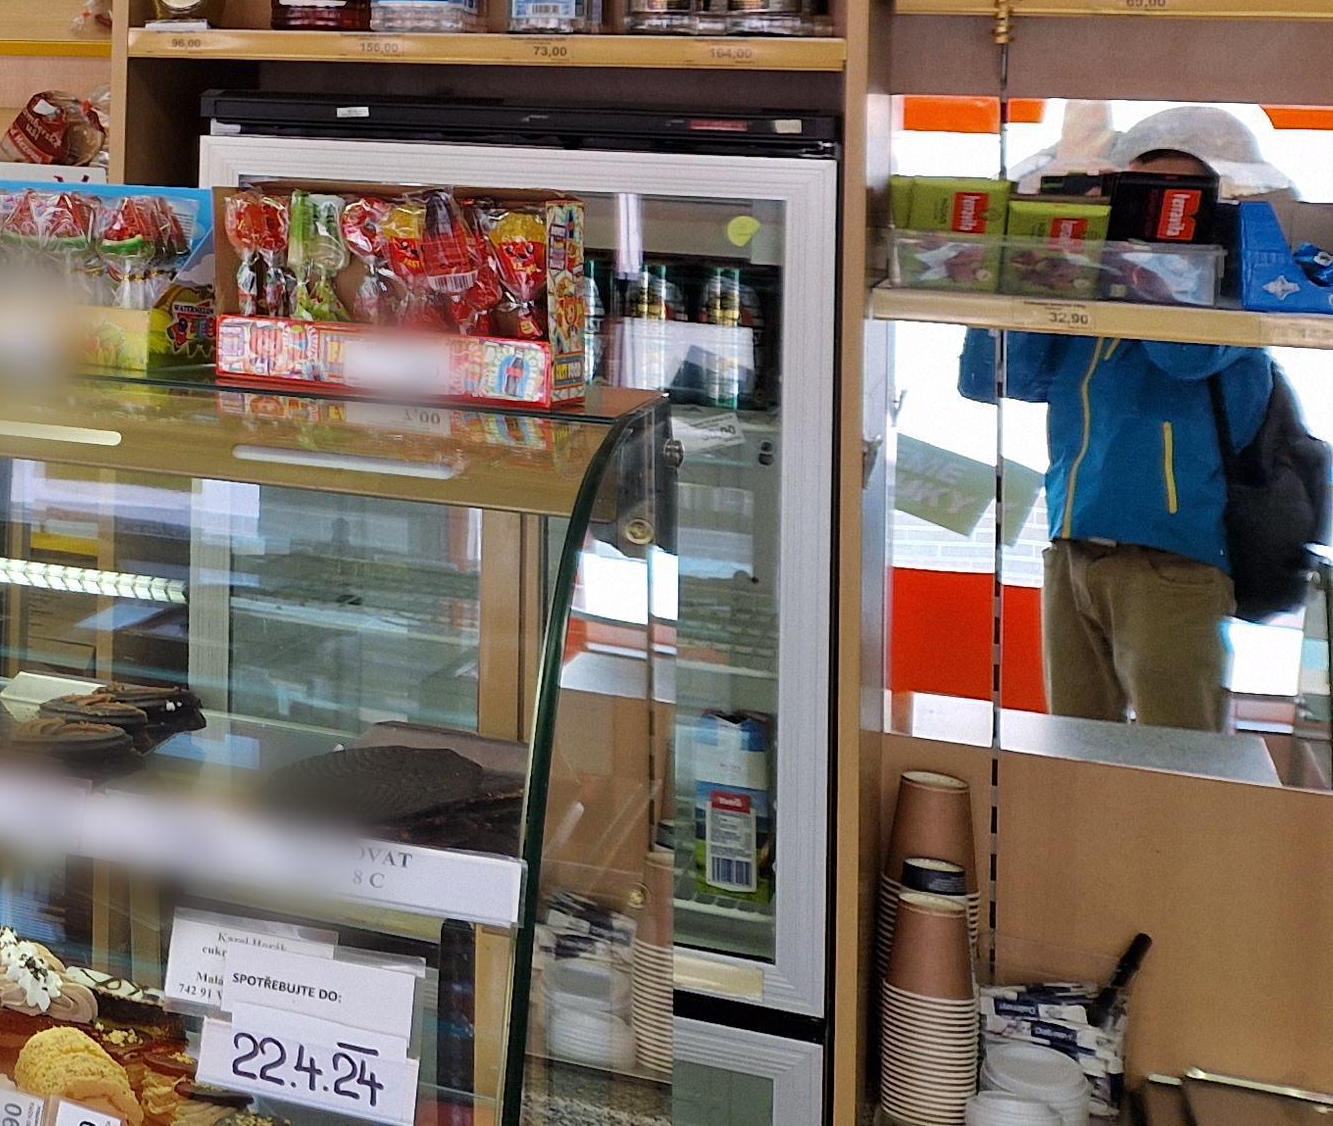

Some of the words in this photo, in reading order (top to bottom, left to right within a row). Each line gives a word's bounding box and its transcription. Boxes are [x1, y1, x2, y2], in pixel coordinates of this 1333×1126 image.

[533, 46, 567, 57] 73,00
[1048, 312, 1090, 325] 32,90
[197, 972, 224, 985] Malá
[179, 983, 197, 996] 742
[200, 988, 212, 1000] 91
[233, 972, 315, 998] SPOTŘEBUJTE
[319, 988, 342, 1003] DO:
[232, 1032, 384, 1107] 22.4.24
